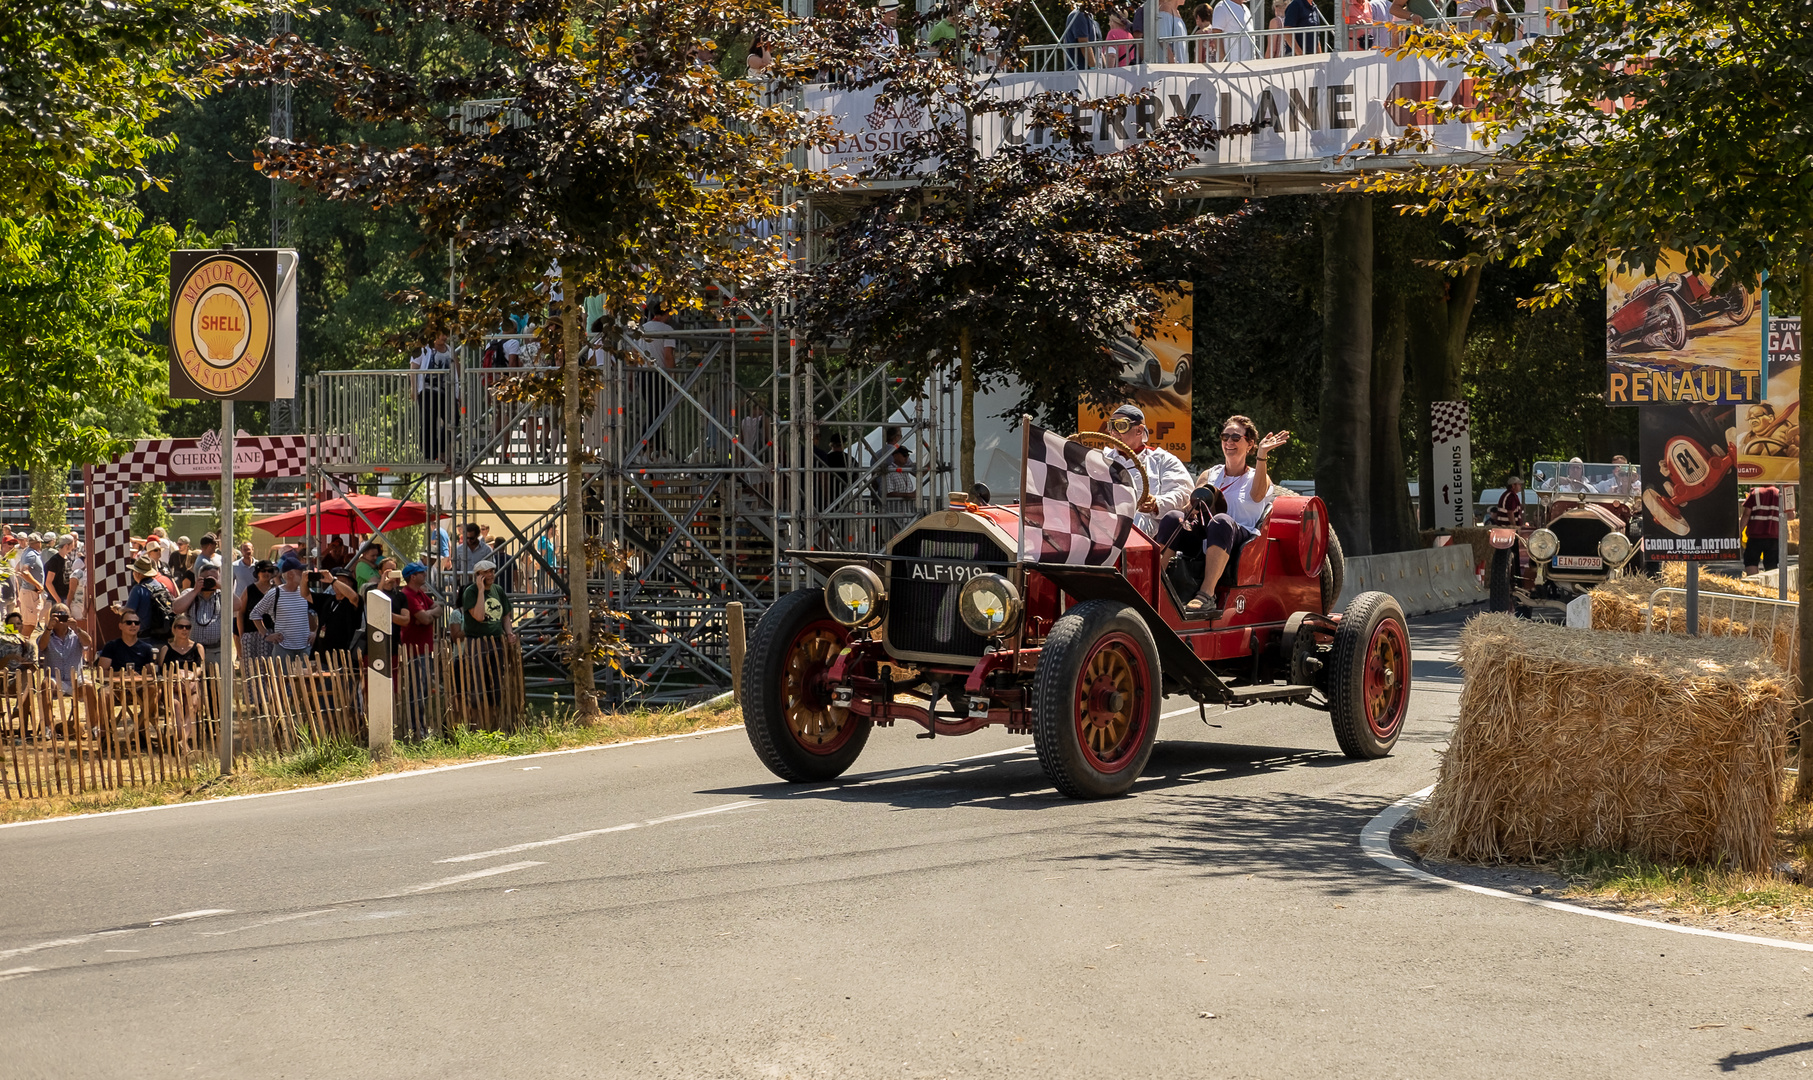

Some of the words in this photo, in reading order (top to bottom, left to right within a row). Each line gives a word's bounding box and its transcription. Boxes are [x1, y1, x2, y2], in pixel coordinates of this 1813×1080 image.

[183, 264, 234, 305] MOTOR
[237, 272, 259, 308] OIL
[201, 315, 241, 332] SHELL
[184, 349, 258, 389] GASOLINE
[1610, 370, 1760, 402] RENAULT
[172, 453, 222, 466] CHERRY
[233, 451, 261, 463] ANE
[1165, 442, 1187, 451] 1938
[1452, 445, 1463, 495] LEGENDS
[1676, 448, 1700, 476] 21
[1454, 497, 1464, 528] ACING
[1645, 538, 1674, 551] GRAND
[1676, 538, 1696, 551] PRIX
[1701, 537, 1740, 550] NATIONS
[1558, 557, 1573, 566] EIN
[1577, 557, 1601, 567] 07930
